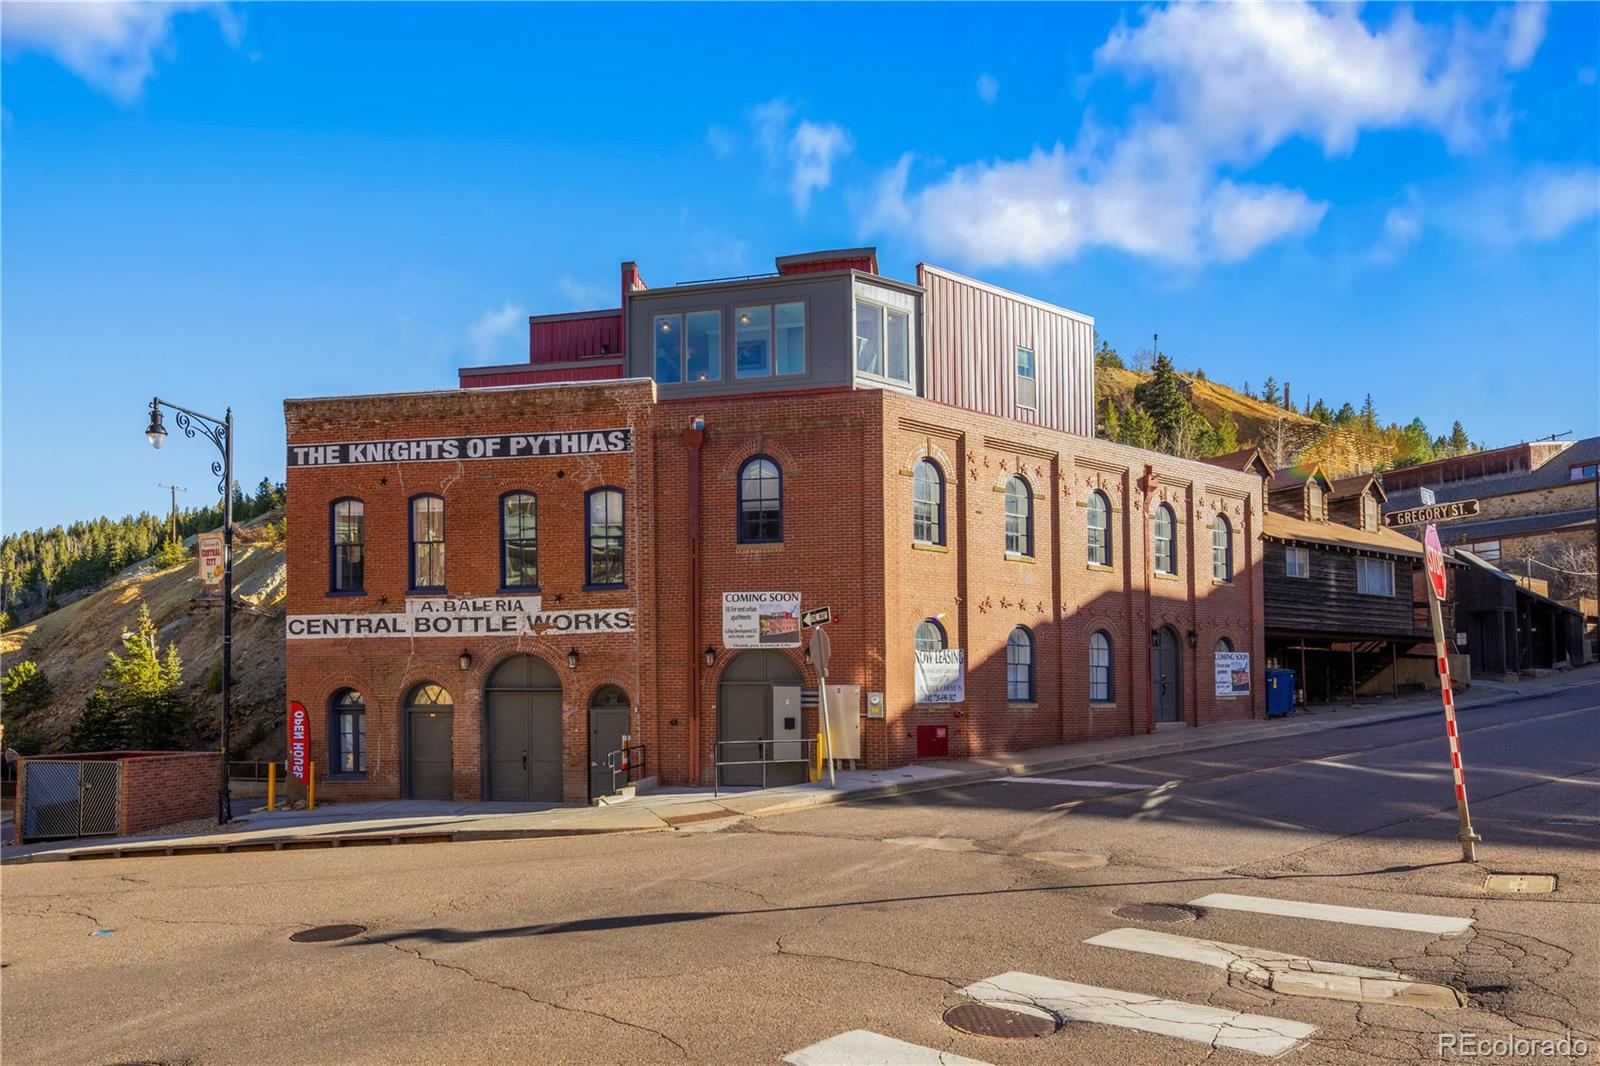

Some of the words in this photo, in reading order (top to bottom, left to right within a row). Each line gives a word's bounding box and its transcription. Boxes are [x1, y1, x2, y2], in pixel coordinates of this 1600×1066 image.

[294, 445, 340, 466] THE
[349, 440, 460, 462] KNIGHTS
[466, 437, 502, 459] OF
[509, 431, 626, 456] PYTHIAS
[1397, 508, 1448, 524] GREGORY
[1451, 503, 1468, 517] ST.
[1427, 544, 1444, 575] STOP
[444, 599, 524, 612] BALERIA
[725, 593, 767, 603] COMING
[769, 593, 799, 602] SOON
[288, 617, 406, 636] CENTRAL
[414, 616, 518, 634] BOTTLE
[527, 611, 631, 631] WORKS
[935, 649, 964, 664] LEASING
